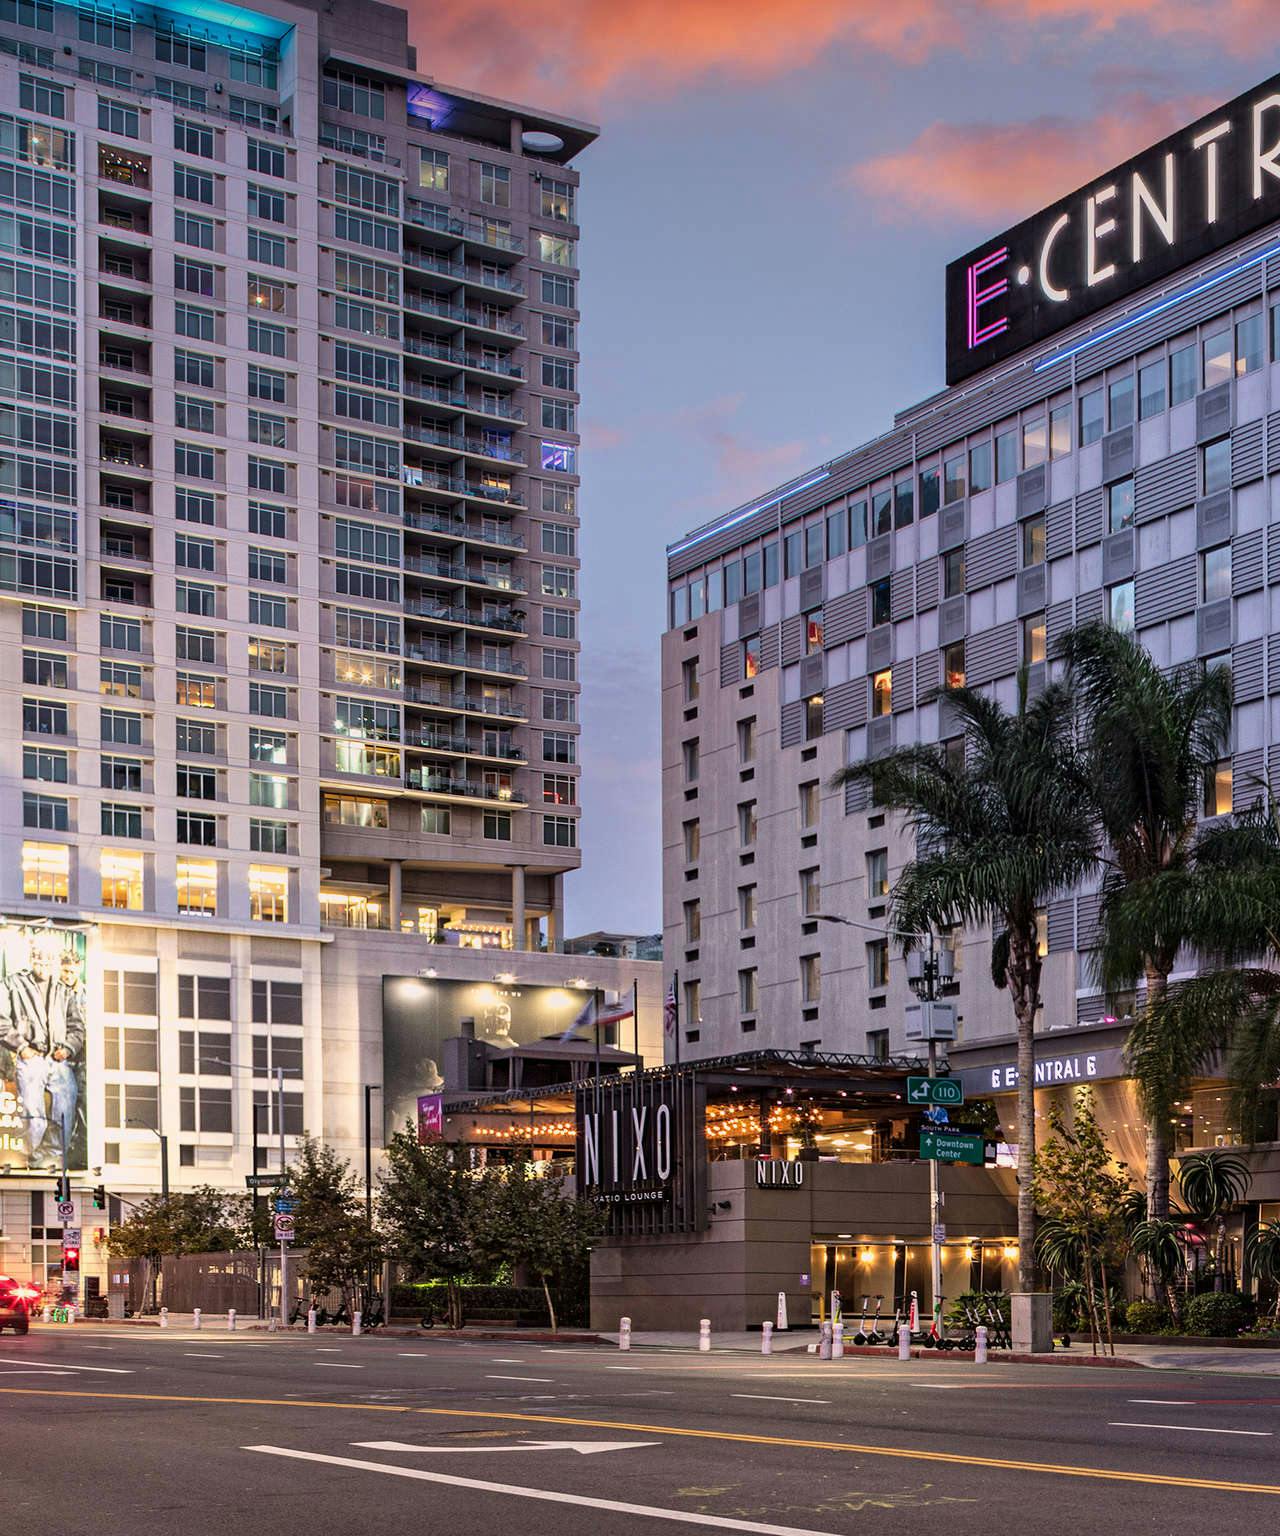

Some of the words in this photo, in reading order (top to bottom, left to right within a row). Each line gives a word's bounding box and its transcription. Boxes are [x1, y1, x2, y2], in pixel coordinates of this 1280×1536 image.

[938, 1087, 955, 1098] 110
[584, 1103, 671, 1186] NIXO
[936, 1138, 974, 1150] Downtown
[936, 1148, 961, 1159] Center
[757, 1160, 803, 1185] NIXO
[624, 1190, 664, 1202] LOUNGE
